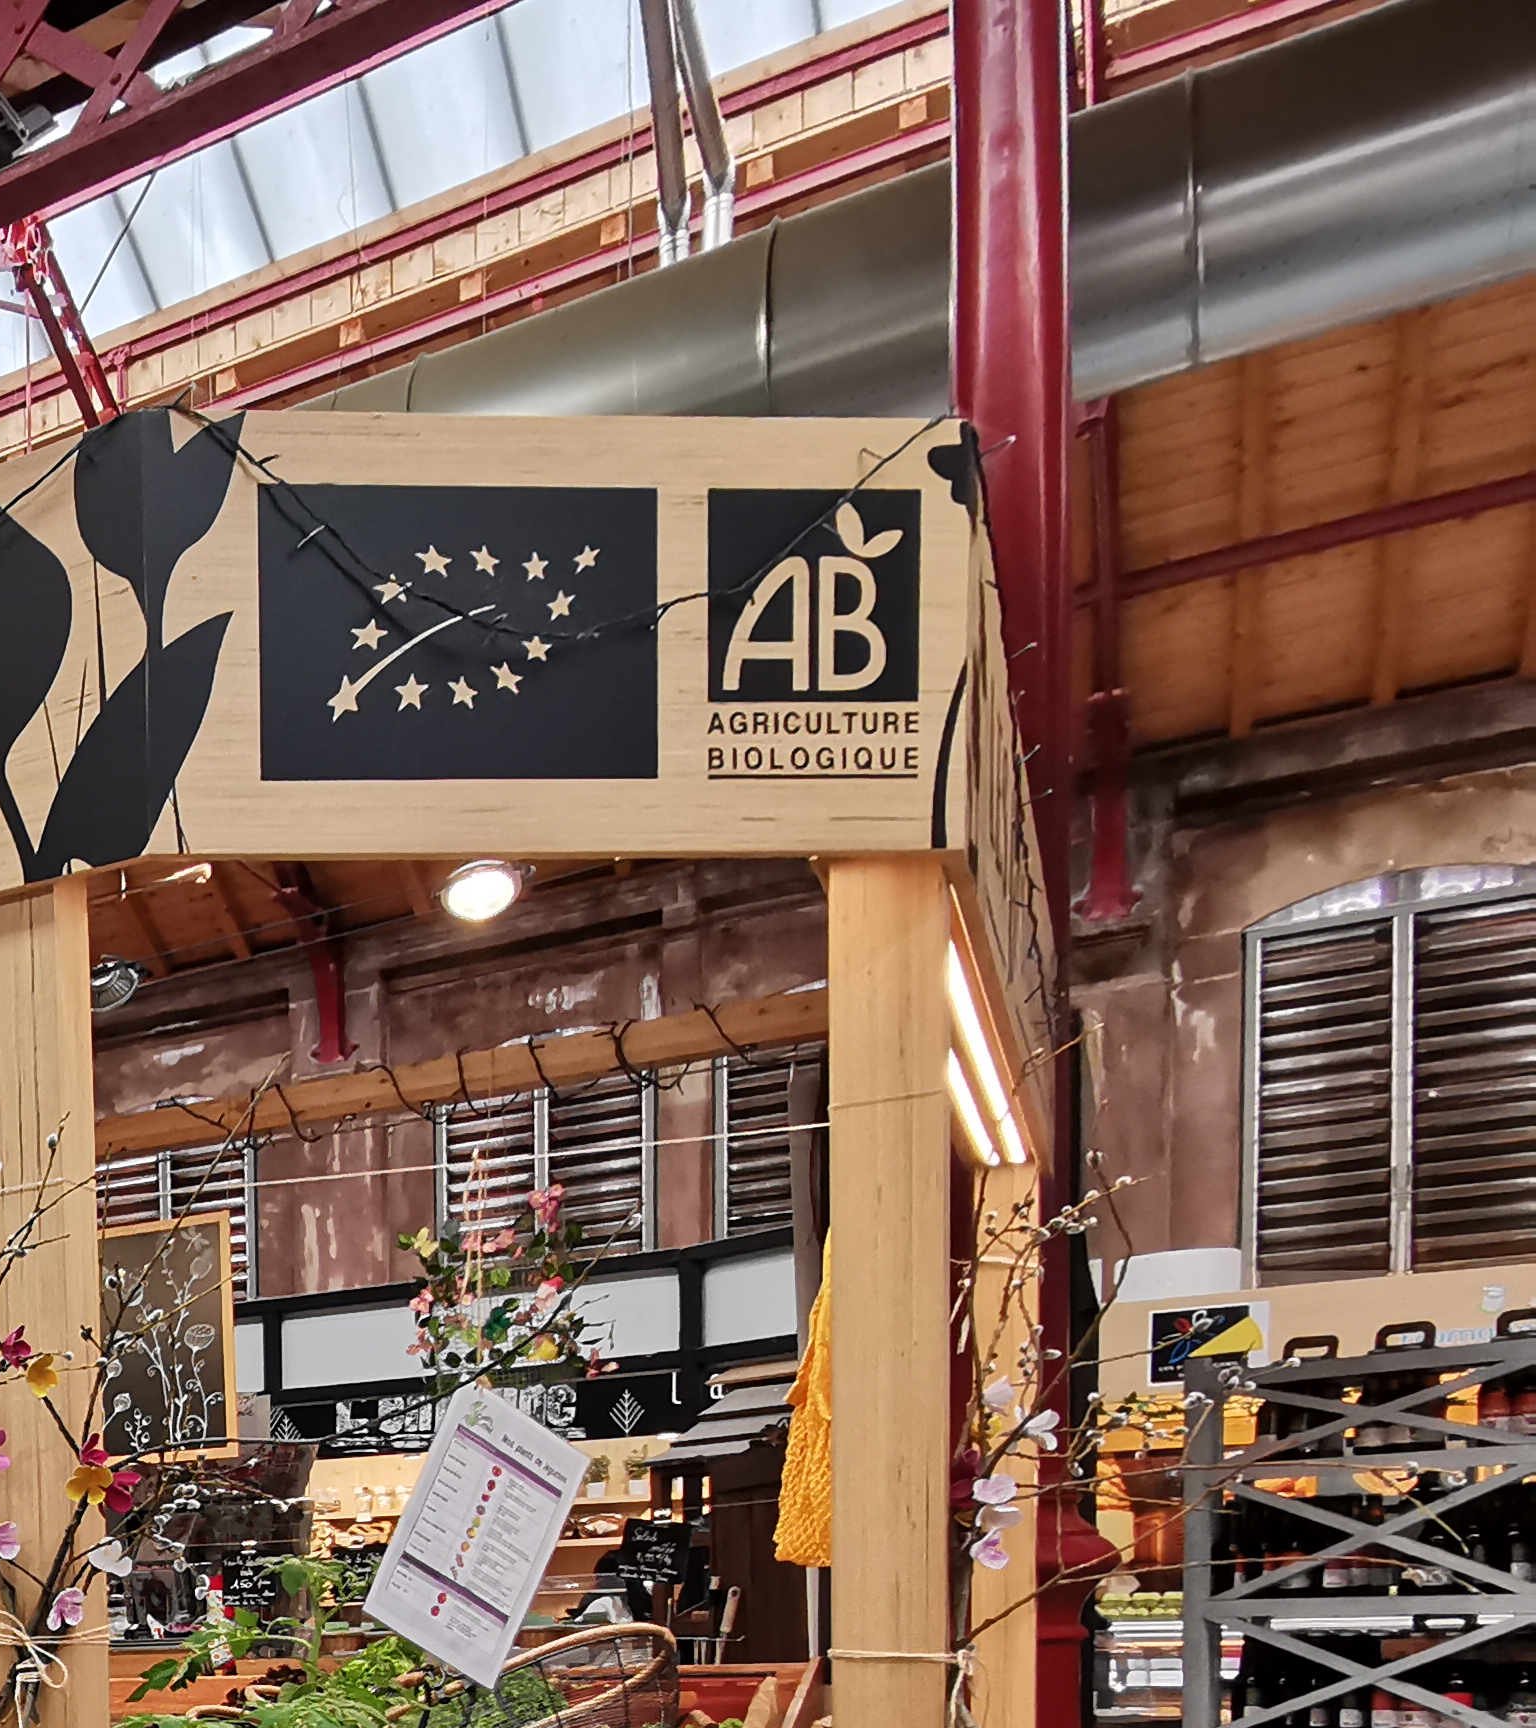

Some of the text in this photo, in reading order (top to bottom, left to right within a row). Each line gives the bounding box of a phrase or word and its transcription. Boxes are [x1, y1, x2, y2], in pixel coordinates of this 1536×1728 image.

[722, 556, 887, 691] AB
[707, 711, 920, 735] AGRICULTURE
[707, 746, 919, 771] BIOLOGIQUE
